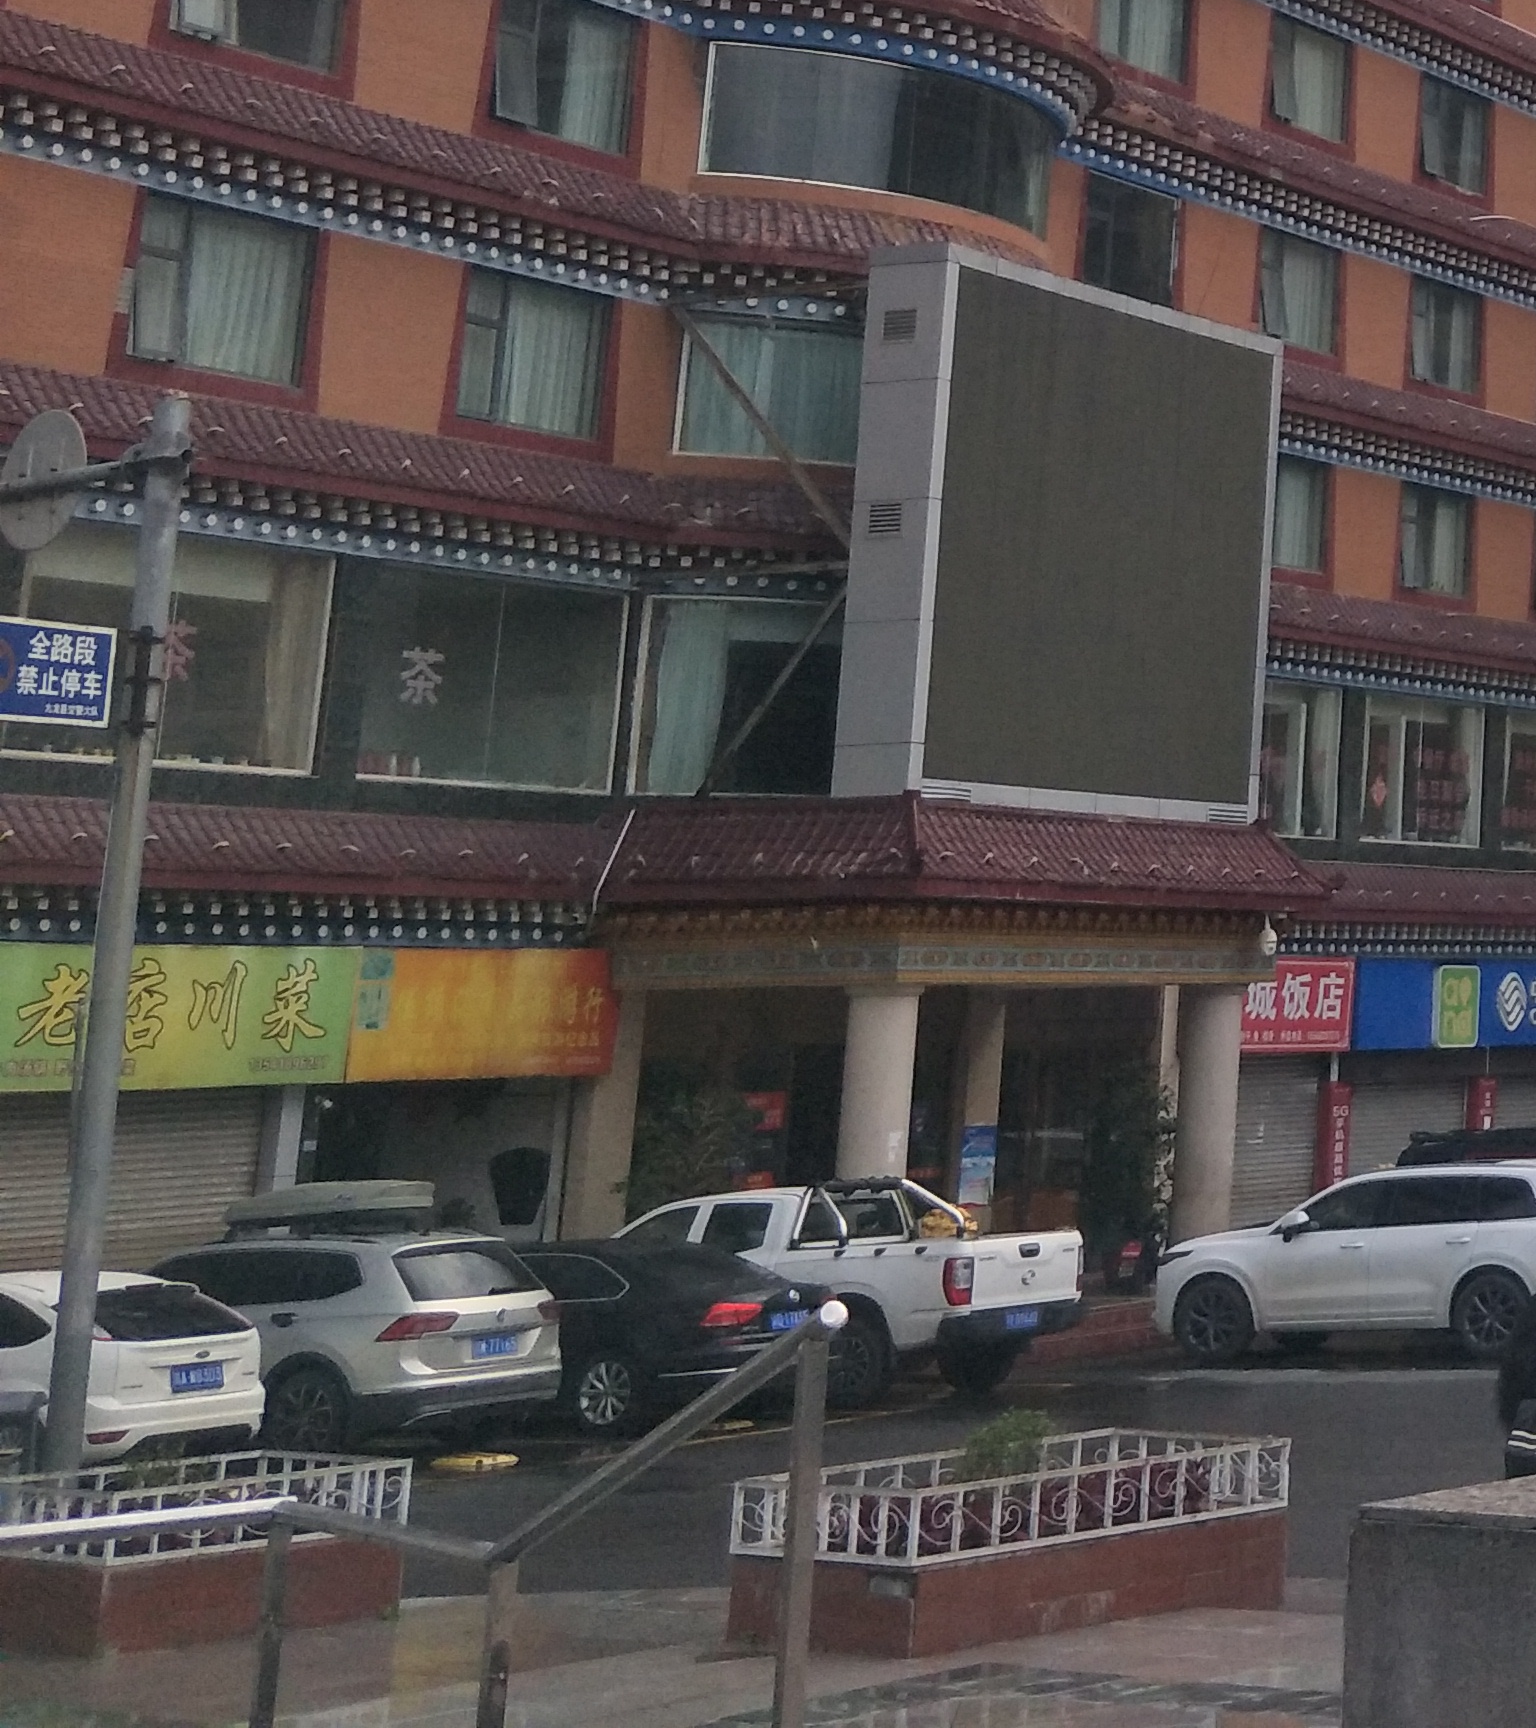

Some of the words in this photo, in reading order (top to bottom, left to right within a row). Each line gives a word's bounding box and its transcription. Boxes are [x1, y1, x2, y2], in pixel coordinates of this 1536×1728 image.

[27, 630, 99, 667] 全路段
[16, 663, 104, 701] 禁止停车
[400, 646, 445, 705] 茶
[1244, 971, 1347, 1022] 城饭店
